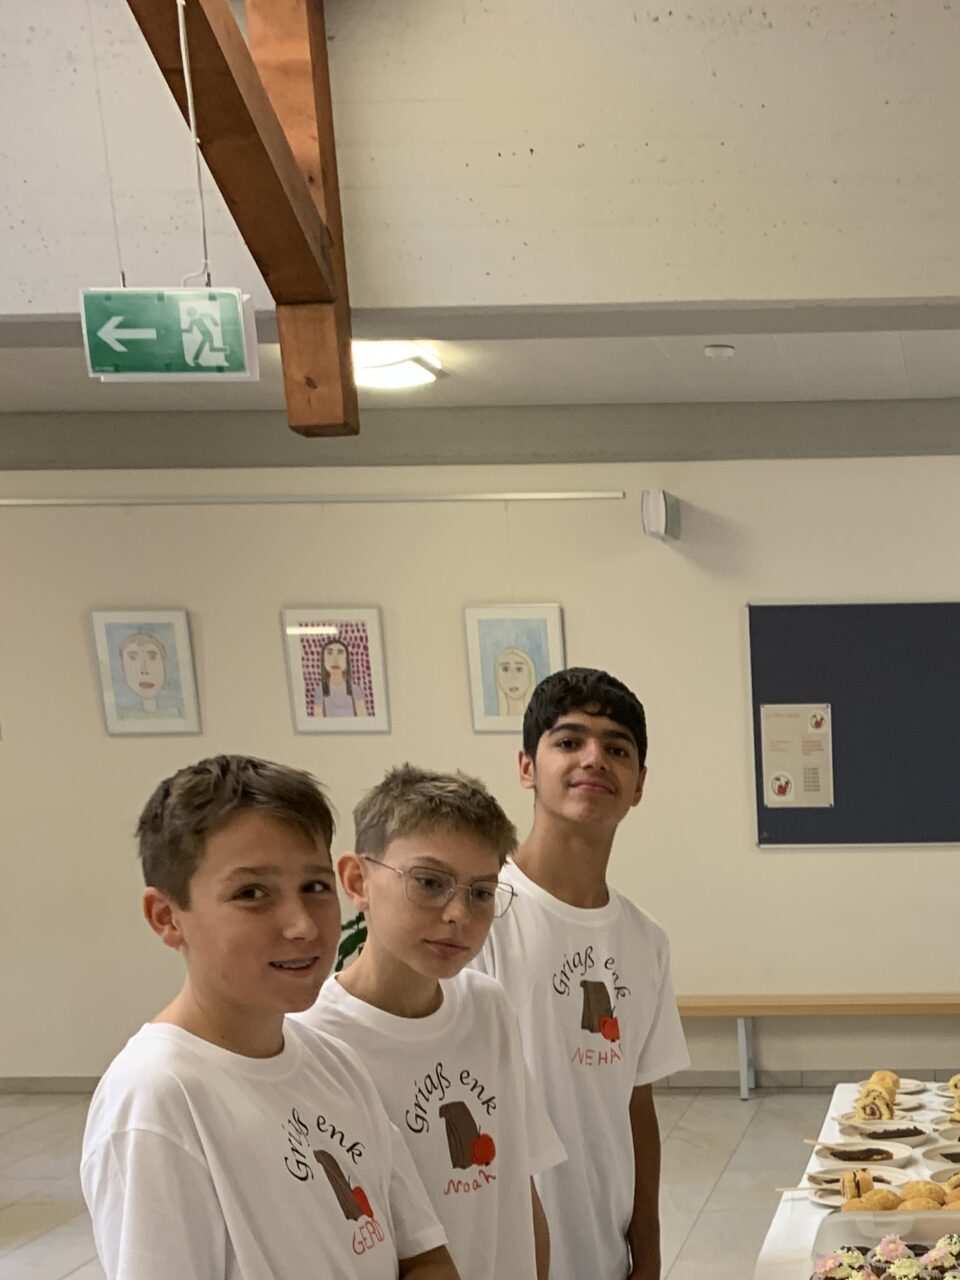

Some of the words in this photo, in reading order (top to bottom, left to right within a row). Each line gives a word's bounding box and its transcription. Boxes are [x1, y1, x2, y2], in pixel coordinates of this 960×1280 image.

[551, 945, 595, 997] Griaß
[604, 957, 631, 999] enk
[405, 1061, 452, 1134] Griaß
[459, 1069, 497, 1116] enk
[316, 1115, 366, 1165] enk
[443, 1168, 497, 1196] Noah
